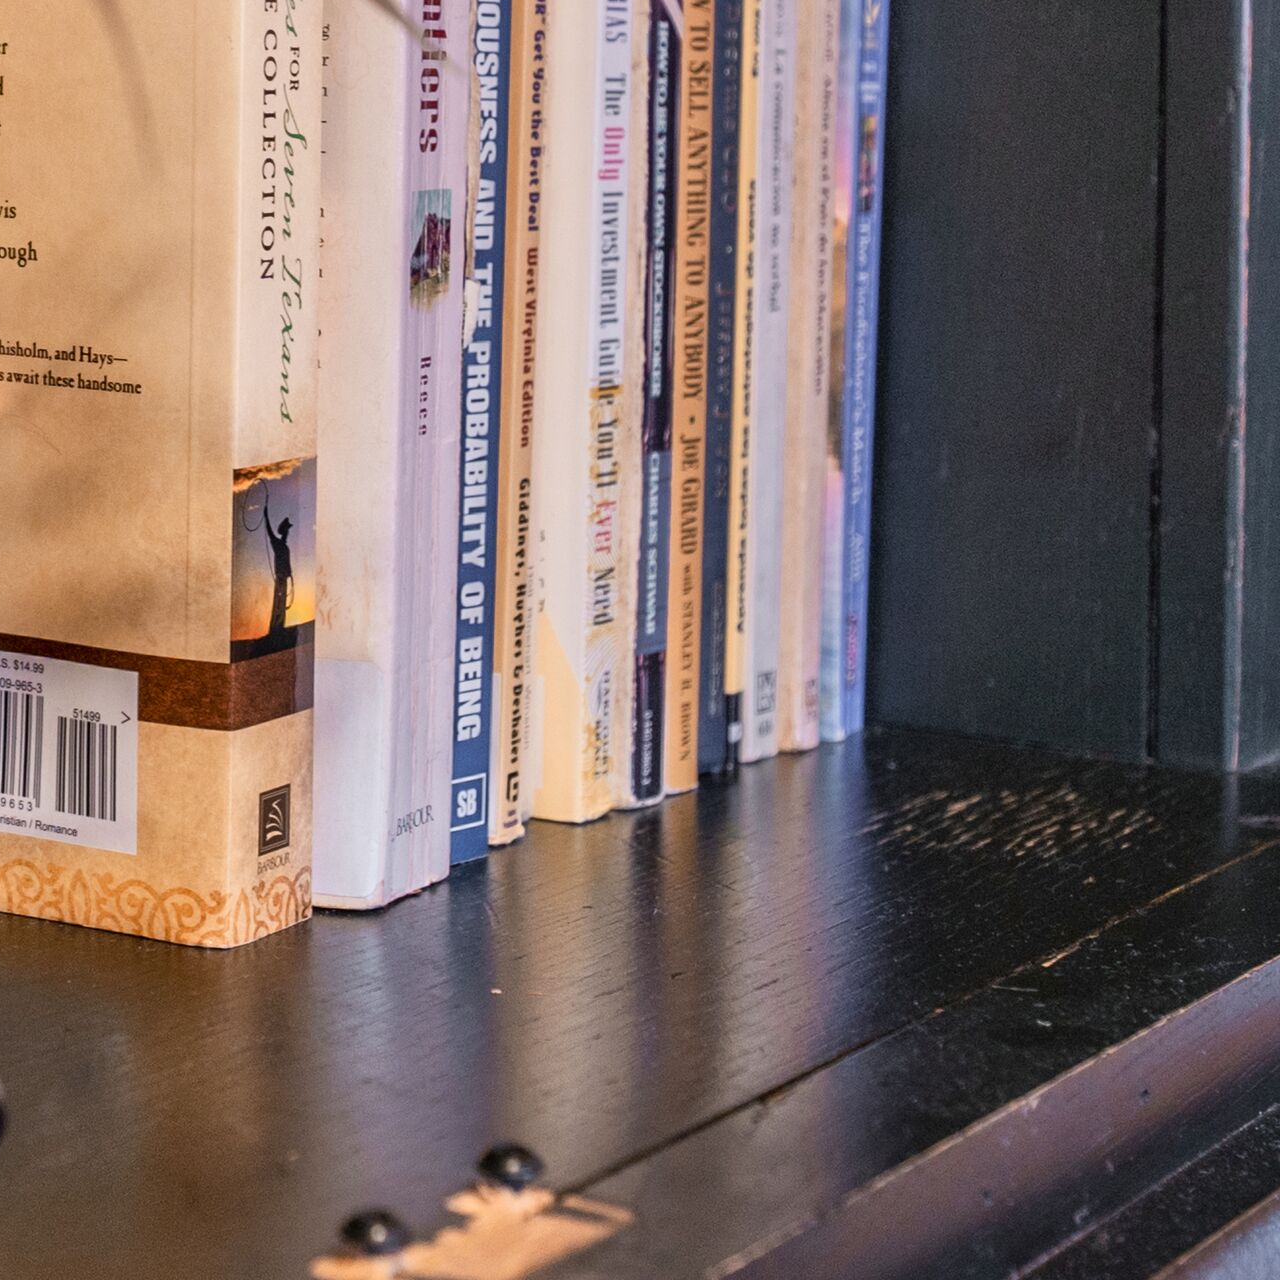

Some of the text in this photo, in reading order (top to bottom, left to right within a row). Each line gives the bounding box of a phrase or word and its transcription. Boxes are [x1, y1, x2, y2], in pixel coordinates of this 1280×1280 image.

[533, 30, 546, 61] Get
[656, 20, 670, 75] HOW
[688, 23, 711, 51] TO
[288, 47, 300, 91] FOR
[604, 74, 626, 116] The
[656, 77, 669, 104] TO
[687, 63, 710, 118] SELL
[531, 110, 544, 140] the
[260, 29, 278, 280] COLLECTION
[283, 83, 307, 241] Seven
[529, 146, 542, 186] Best
[598, 126, 625, 181] Only
[654, 135, 668, 190] YOUR
[528, 193, 541, 232] Deal
[686, 126, 710, 246] ANYTHING
[475, 178, 496, 250] AND
[654, 194, 667, 247] OWN
[526, 247, 539, 296] West
[598, 191, 623, 328] Investment
[684, 256, 707, 287] TO
[474, 262, 494, 328] THE
[279, 255, 303, 424] Texans
[522, 301, 537, 374] Virginia
[651, 250, 666, 397] STOCKBROKER
[682, 295, 706, 400] ANYBODY
[6, 368, 39, 386] await
[42, 371, 75, 388] these
[77, 373, 142, 395] handsome
[598, 338, 620, 407] Guide
[521, 381, 534, 448] Edition
[462, 340, 491, 567] PROBABILITY
[679, 434, 701, 472] JOE
[647, 452, 660, 543] CHARLES
[679, 477, 701, 555] GIRARD
[460, 581, 485, 624] OF
[593, 567, 616, 626] Need
[645, 549, 658, 636] SCHWAB
[682, 564, 693, 596] with
[512, 584, 528, 658] Hughes
[680, 599, 695, 674] STANLEY
[13, 659, 45, 674] $14.99
[457, 637, 484, 741] BEING
[72, 708, 101, 722] 51499
[679, 701, 693, 762] BROWN
[34, 820, 79, 837] Romance
[456, 788, 478, 818] SB
[257, 851, 291, 875] BARBOUR
